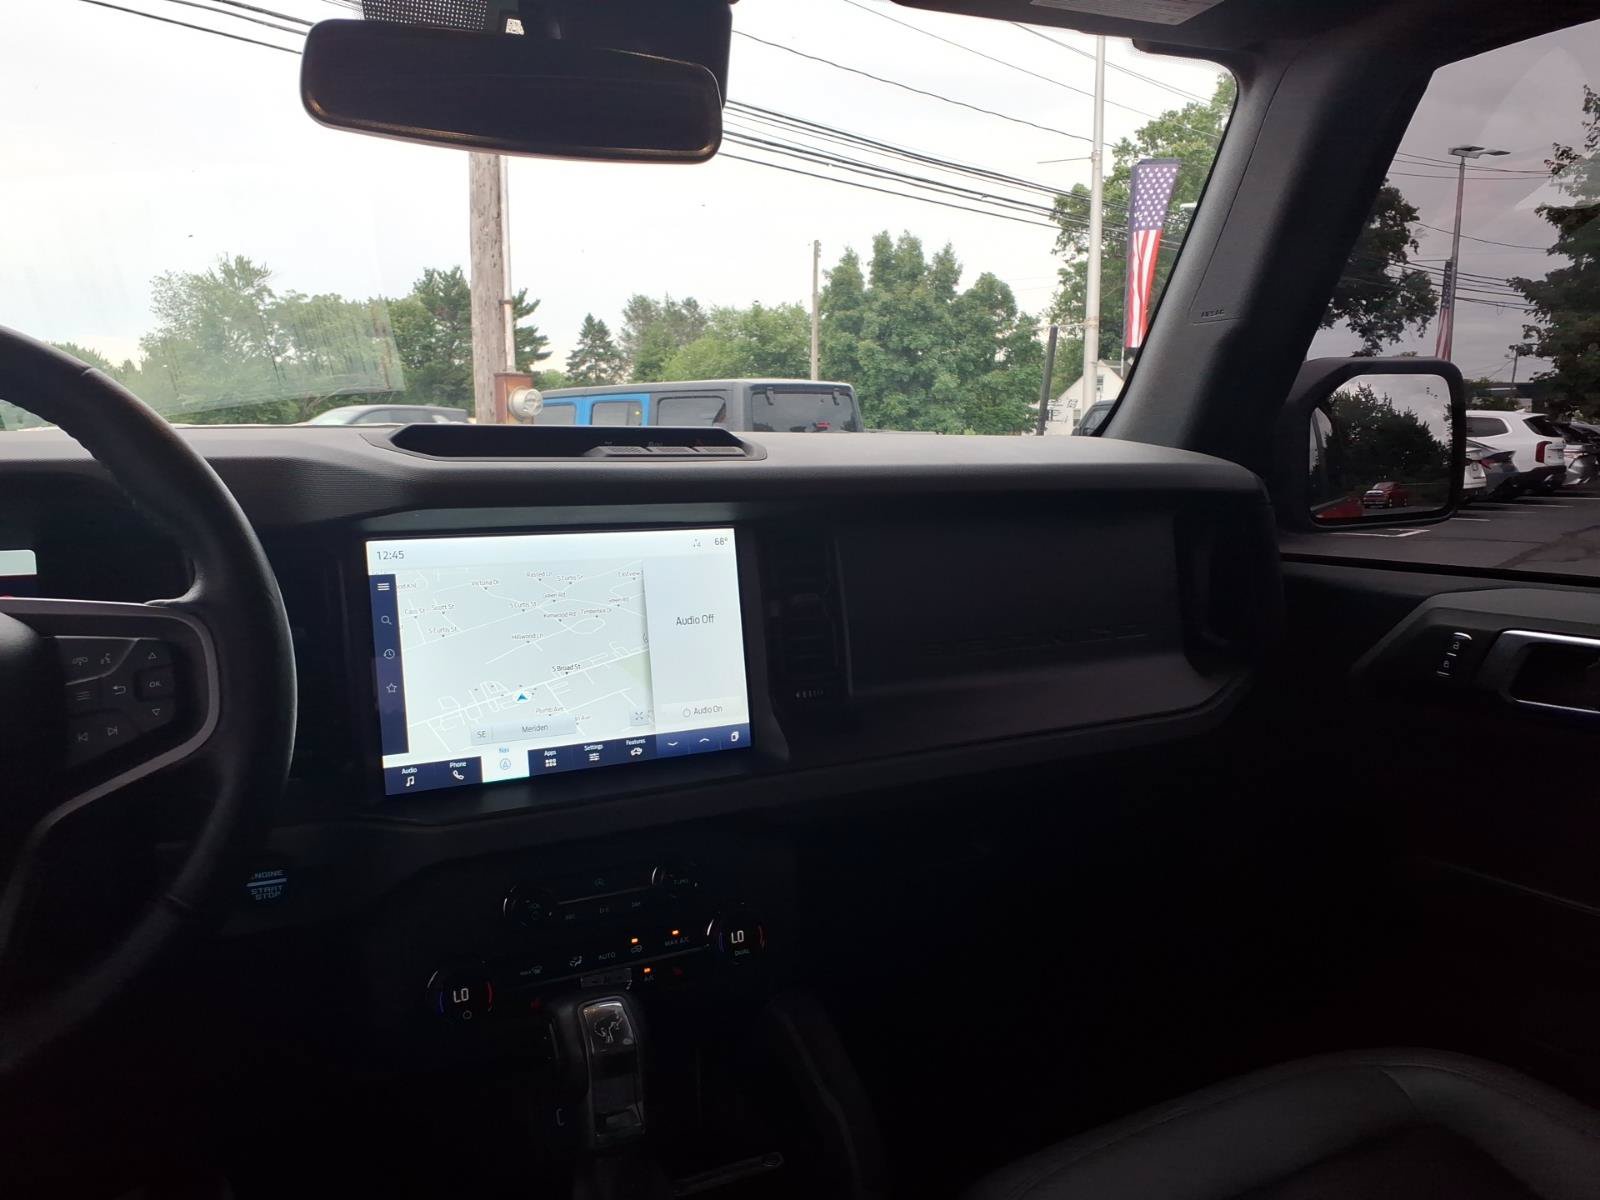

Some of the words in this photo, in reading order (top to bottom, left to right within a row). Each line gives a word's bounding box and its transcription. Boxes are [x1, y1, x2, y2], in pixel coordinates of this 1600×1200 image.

[377, 550, 405, 560] 12:45
[676, 616, 700, 626] Audio
[701, 614, 714, 624] Off
[557, 664, 573, 672] Broad
[694, 705, 712, 715] Audio
[713, 705, 723, 713] On
[521, 724, 548, 733] Meriden
[477, 730, 486, 738] SE
[626, 738, 646, 746] Features
[584, 743, 604, 752] Settings
[449, 761, 467, 769] Phone
[401, 767, 418, 775] Audio
[730, 930, 745, 945] LO
[452, 987, 470, 1003] LO
